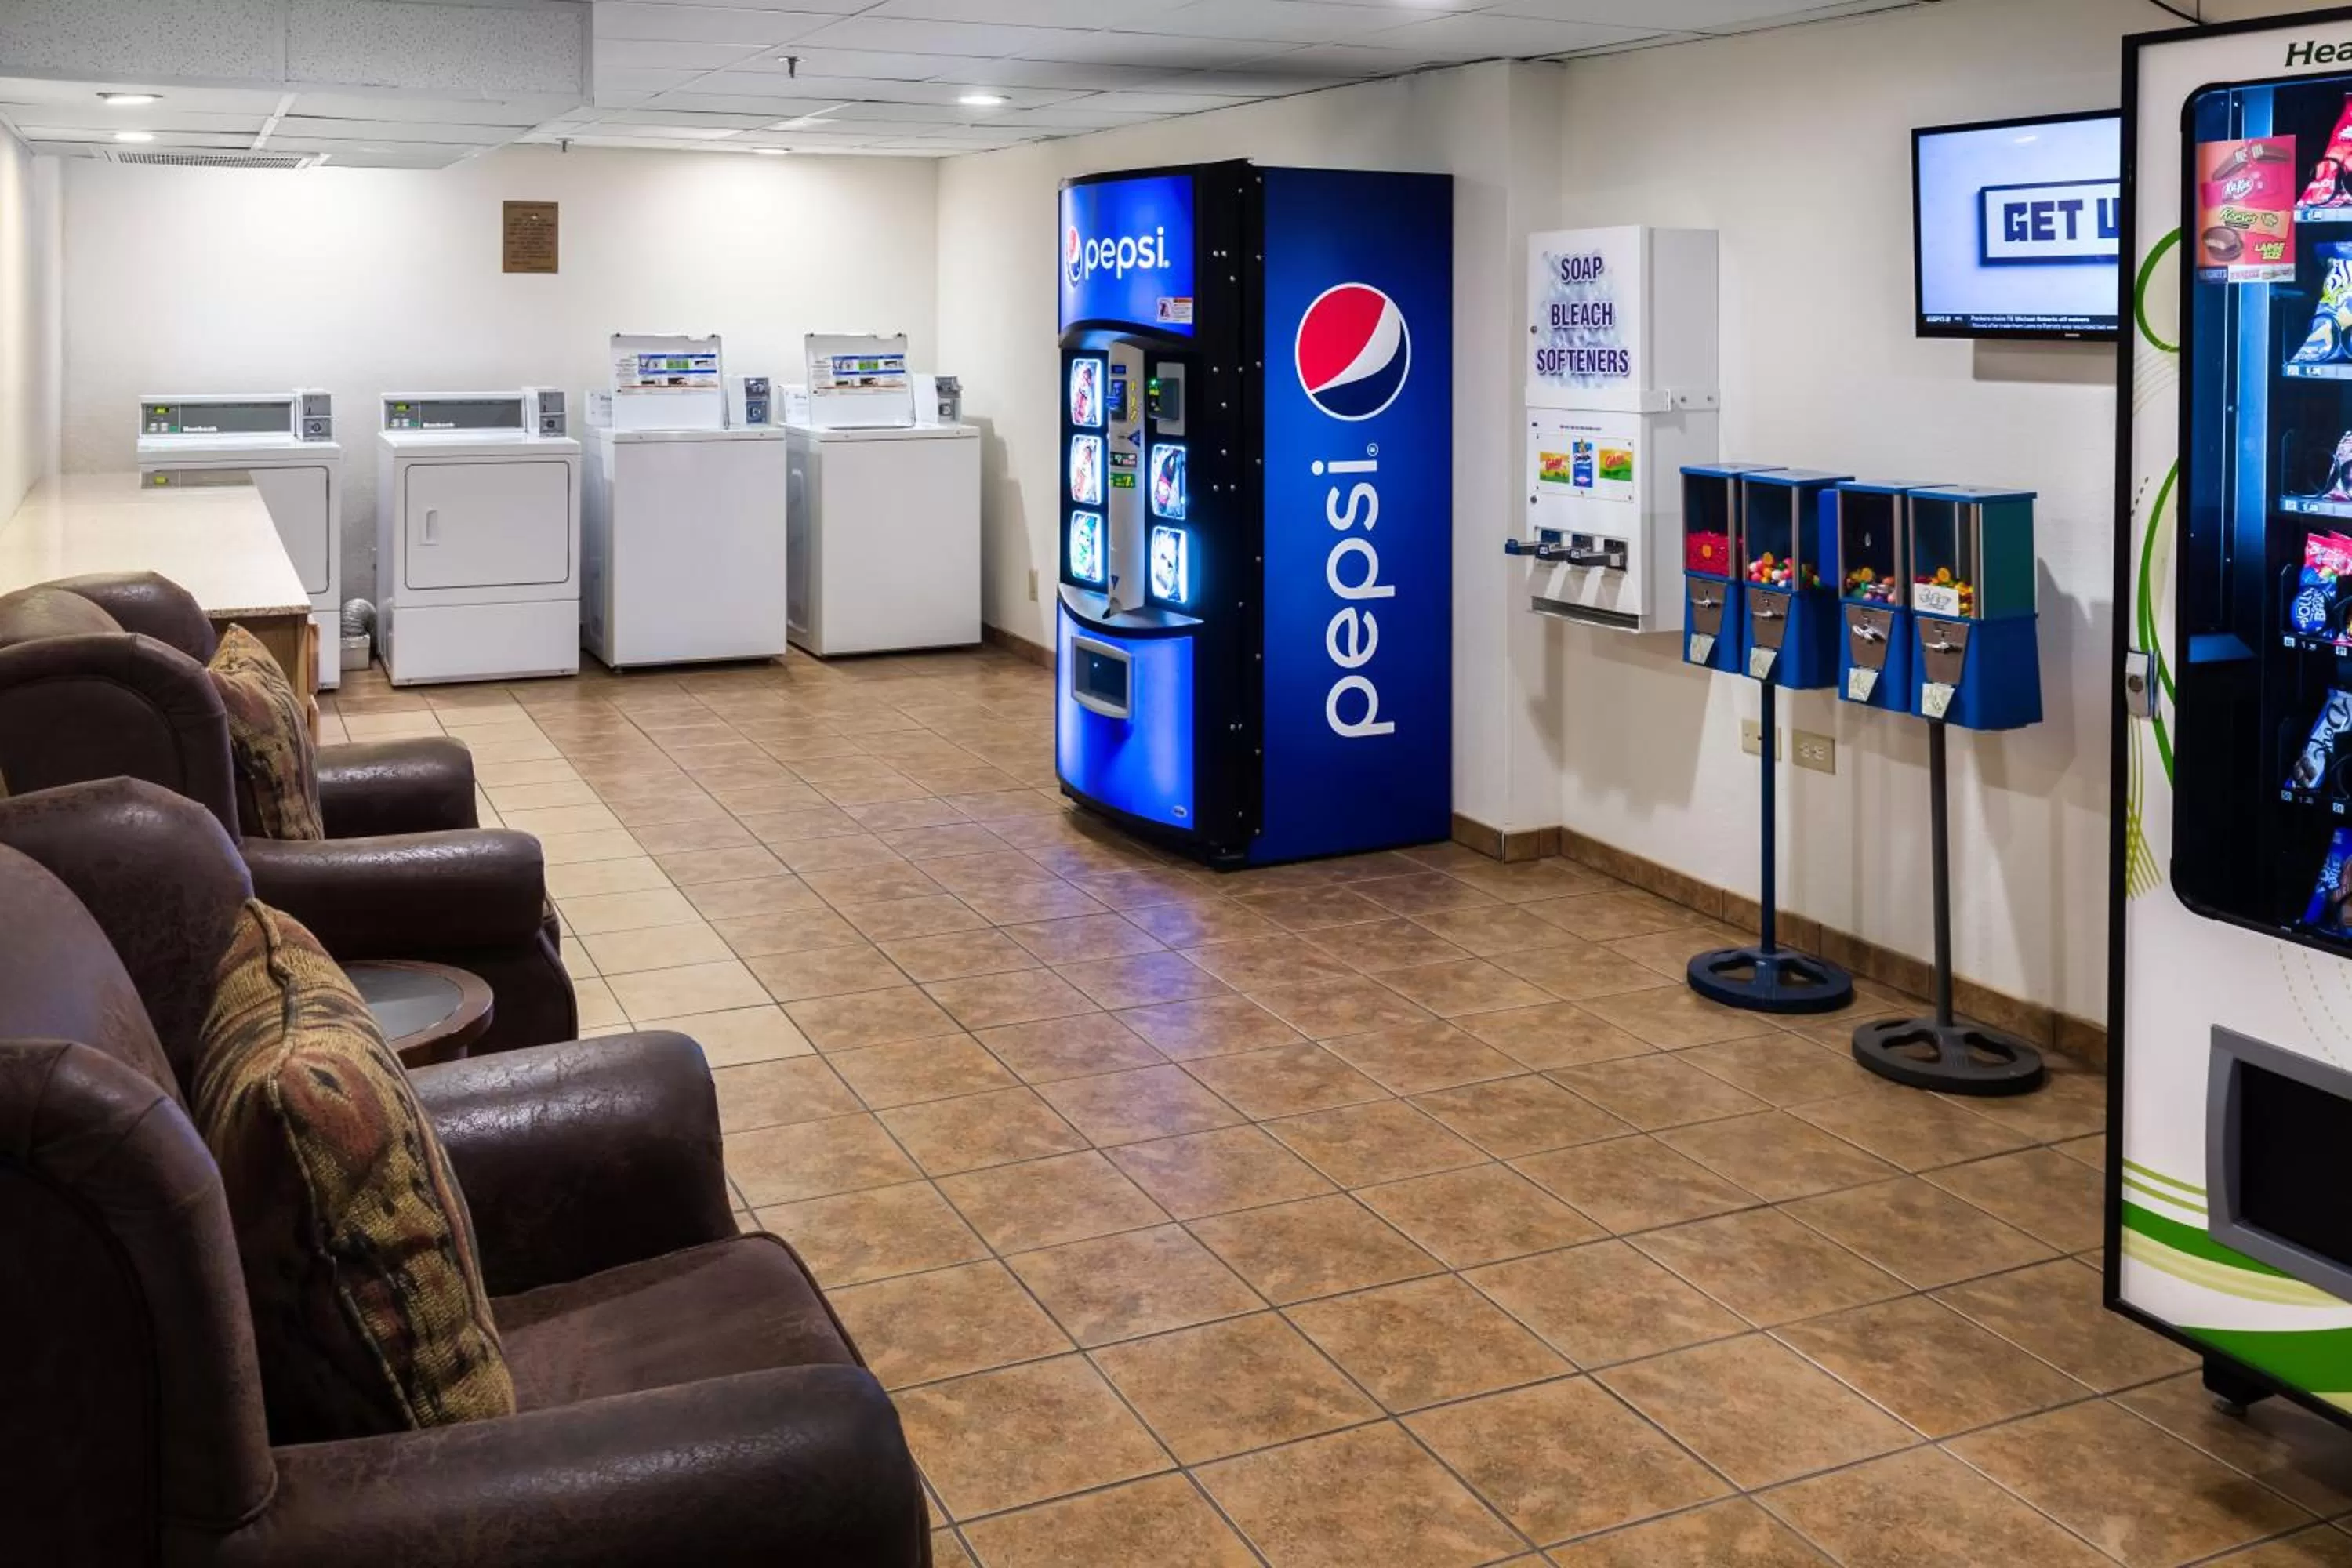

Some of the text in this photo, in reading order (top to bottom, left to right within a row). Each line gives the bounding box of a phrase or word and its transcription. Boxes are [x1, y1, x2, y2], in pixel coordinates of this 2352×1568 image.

[2285, 40, 2352, 67] Hea
[2004, 199, 2084, 242] GET
[1084, 226, 1165, 280] pepsi
[1561, 256, 1603, 281] SOAP
[1552, 303, 1613, 325] BLEACH
[1537, 349, 1629, 372] SOFTENERS
[1312, 459, 1396, 739] pepsi
